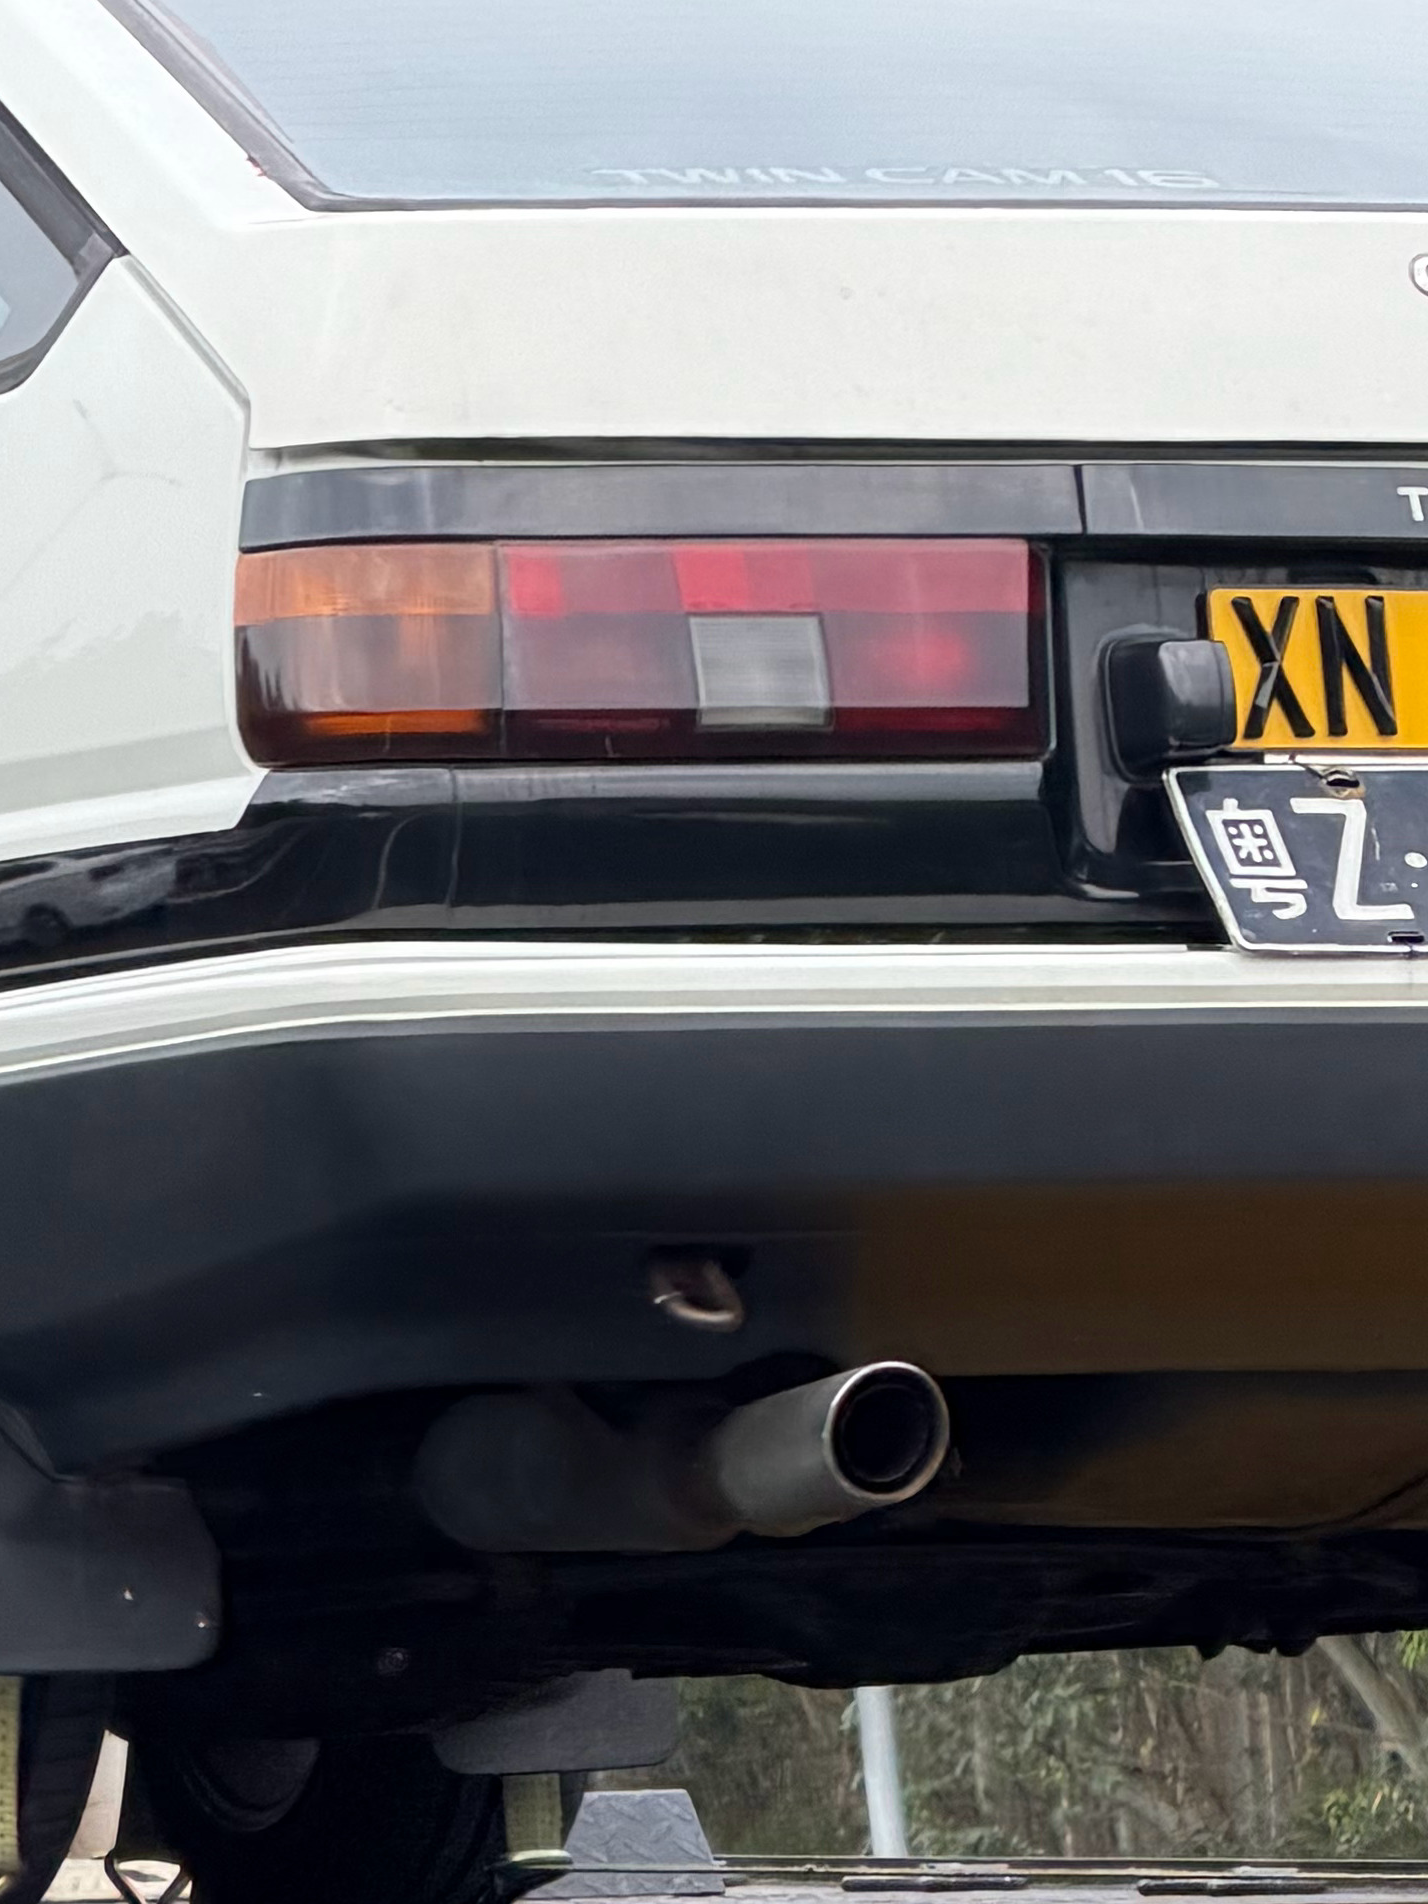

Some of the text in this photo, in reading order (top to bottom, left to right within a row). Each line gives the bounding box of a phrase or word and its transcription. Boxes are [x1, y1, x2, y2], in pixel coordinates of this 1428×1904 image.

[590, 167, 1221, 188] TWIN CAM 16
[1230, 595, 1400, 739] XN
